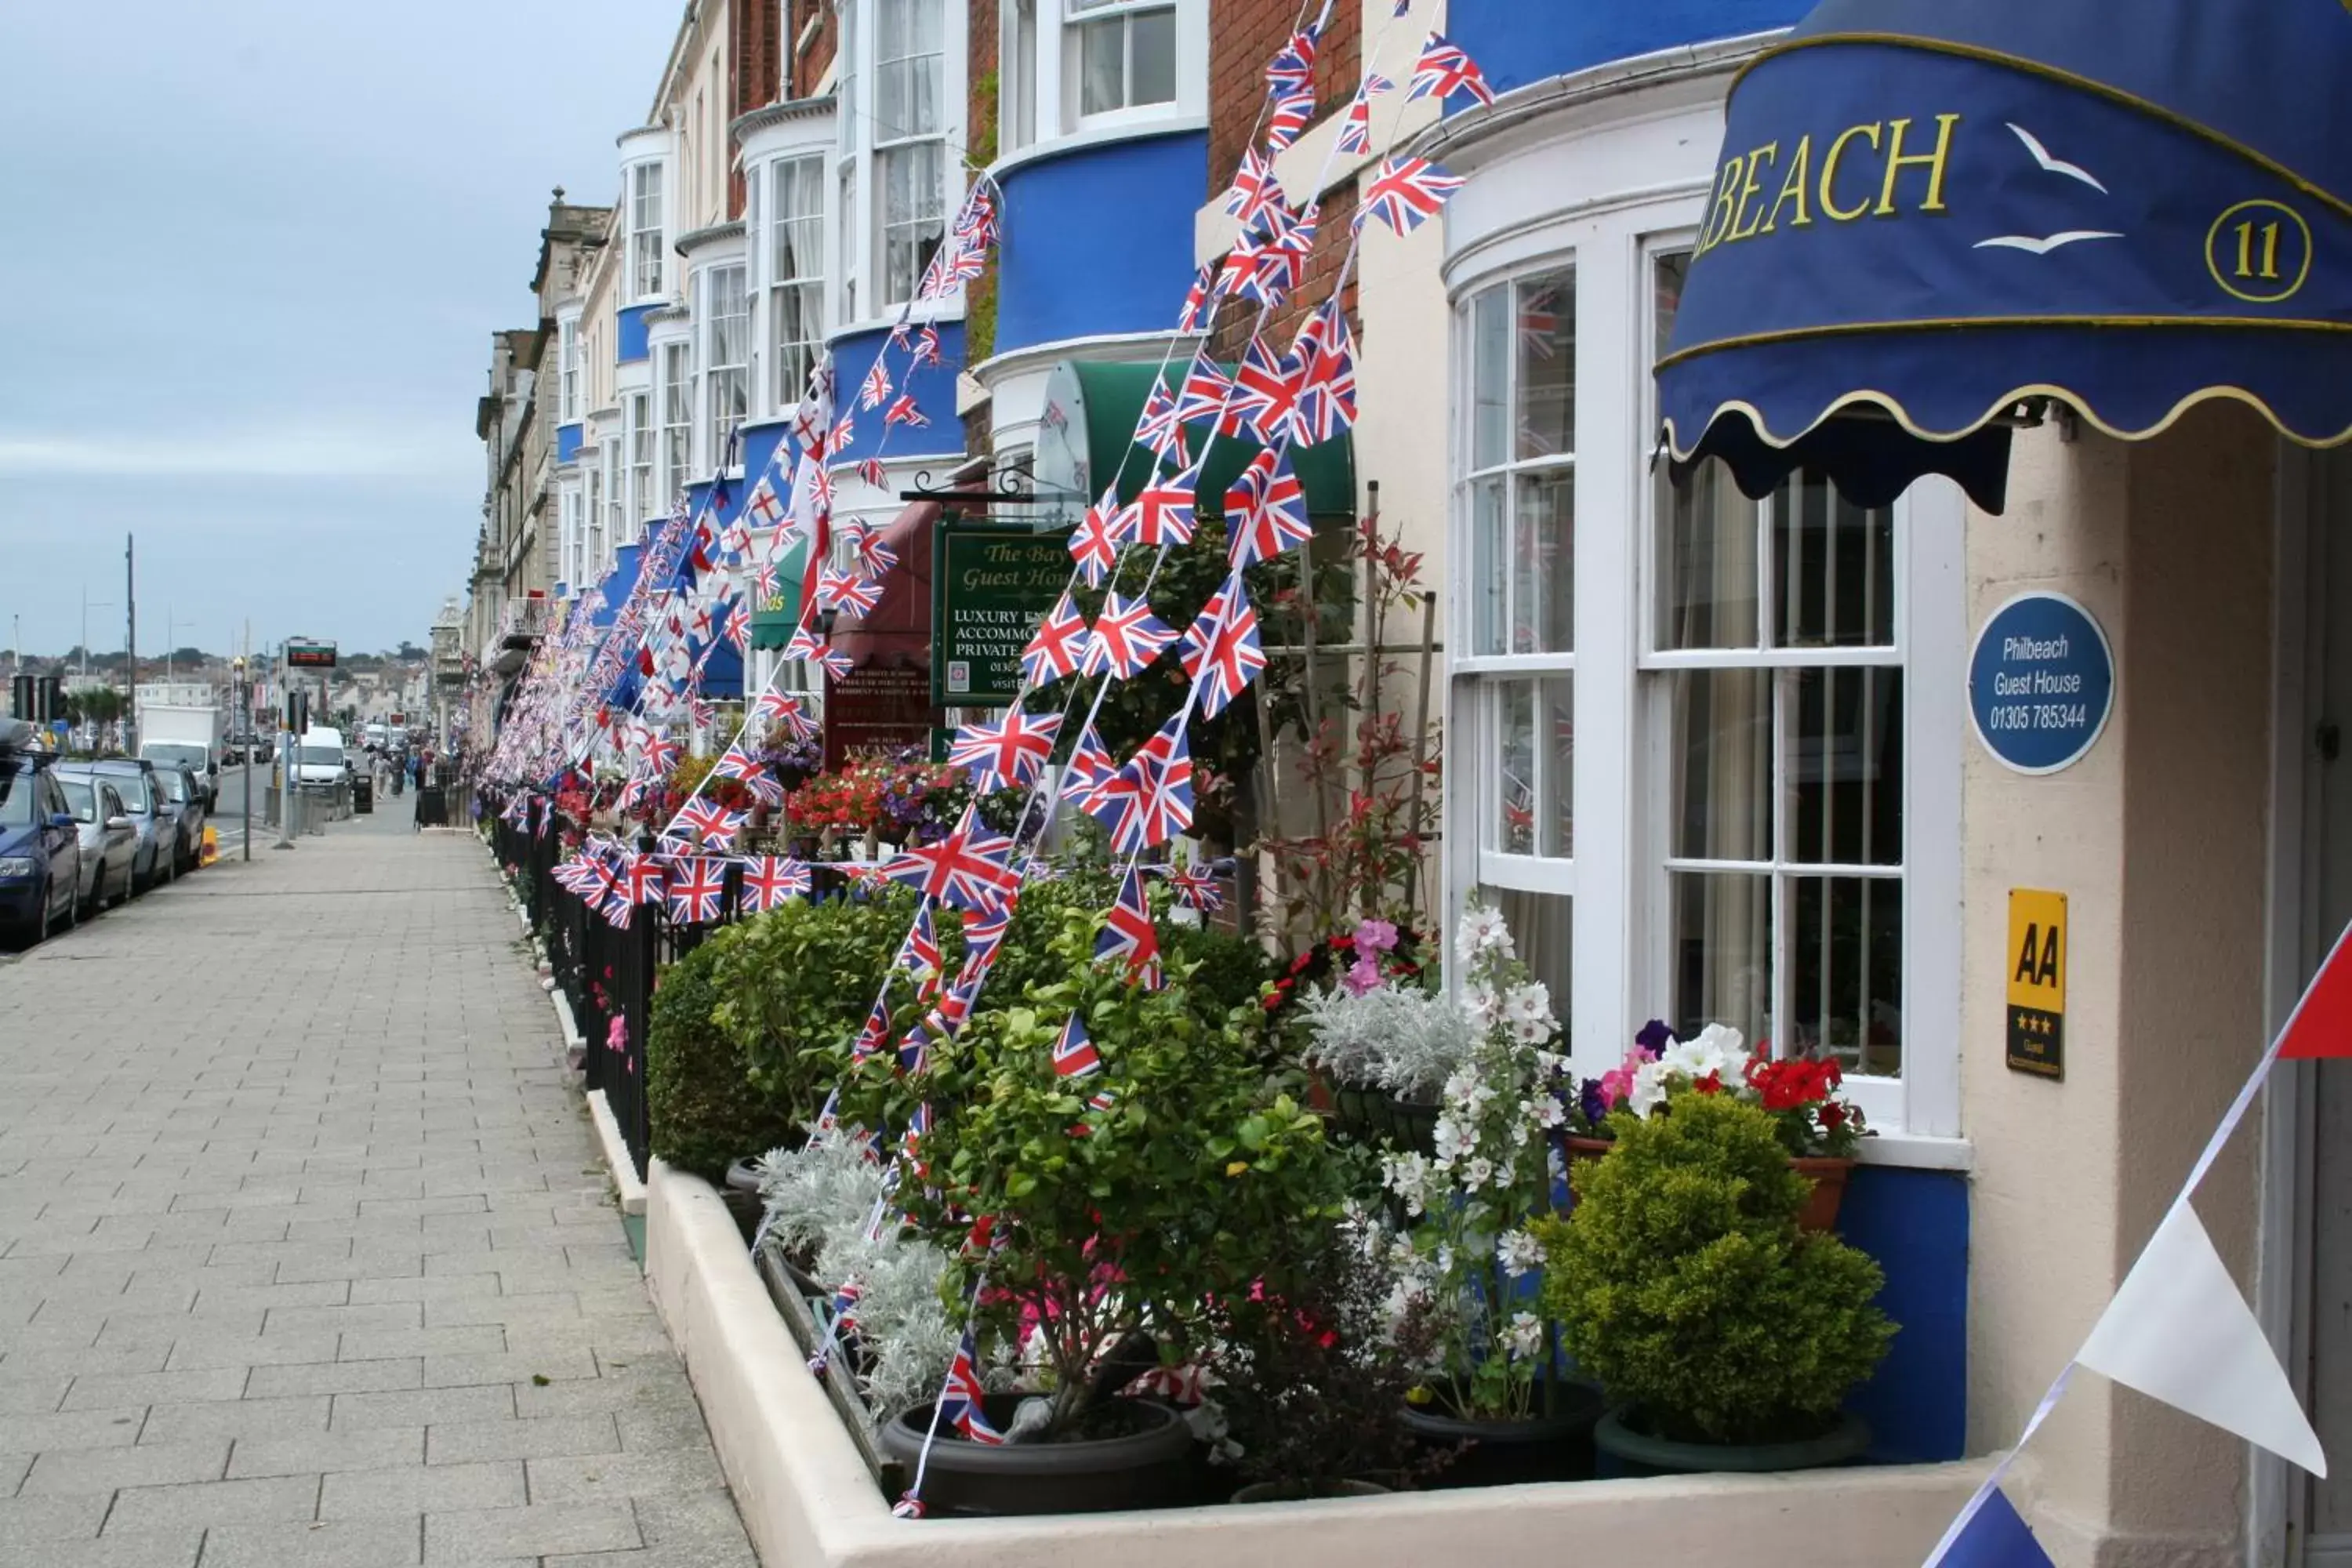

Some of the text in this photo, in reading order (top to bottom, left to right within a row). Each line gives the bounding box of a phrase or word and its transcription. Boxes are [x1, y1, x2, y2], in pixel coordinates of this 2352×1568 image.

[2234, 220, 2279, 278] 11
[983, 541, 1068, 568] The Bay
[963, 568, 1071, 591] Guest Hou
[954, 609, 1019, 624] LUXURY
[955, 626, 1036, 641] ACCOMMO
[956, 644, 1018, 657] PRIVATE
[2003, 633, 2068, 662] Philbeach
[1994, 669, 2082, 696] Guest House
[1990, 703, 2086, 730] 01305 785344
[2014, 922, 2058, 989] AA
